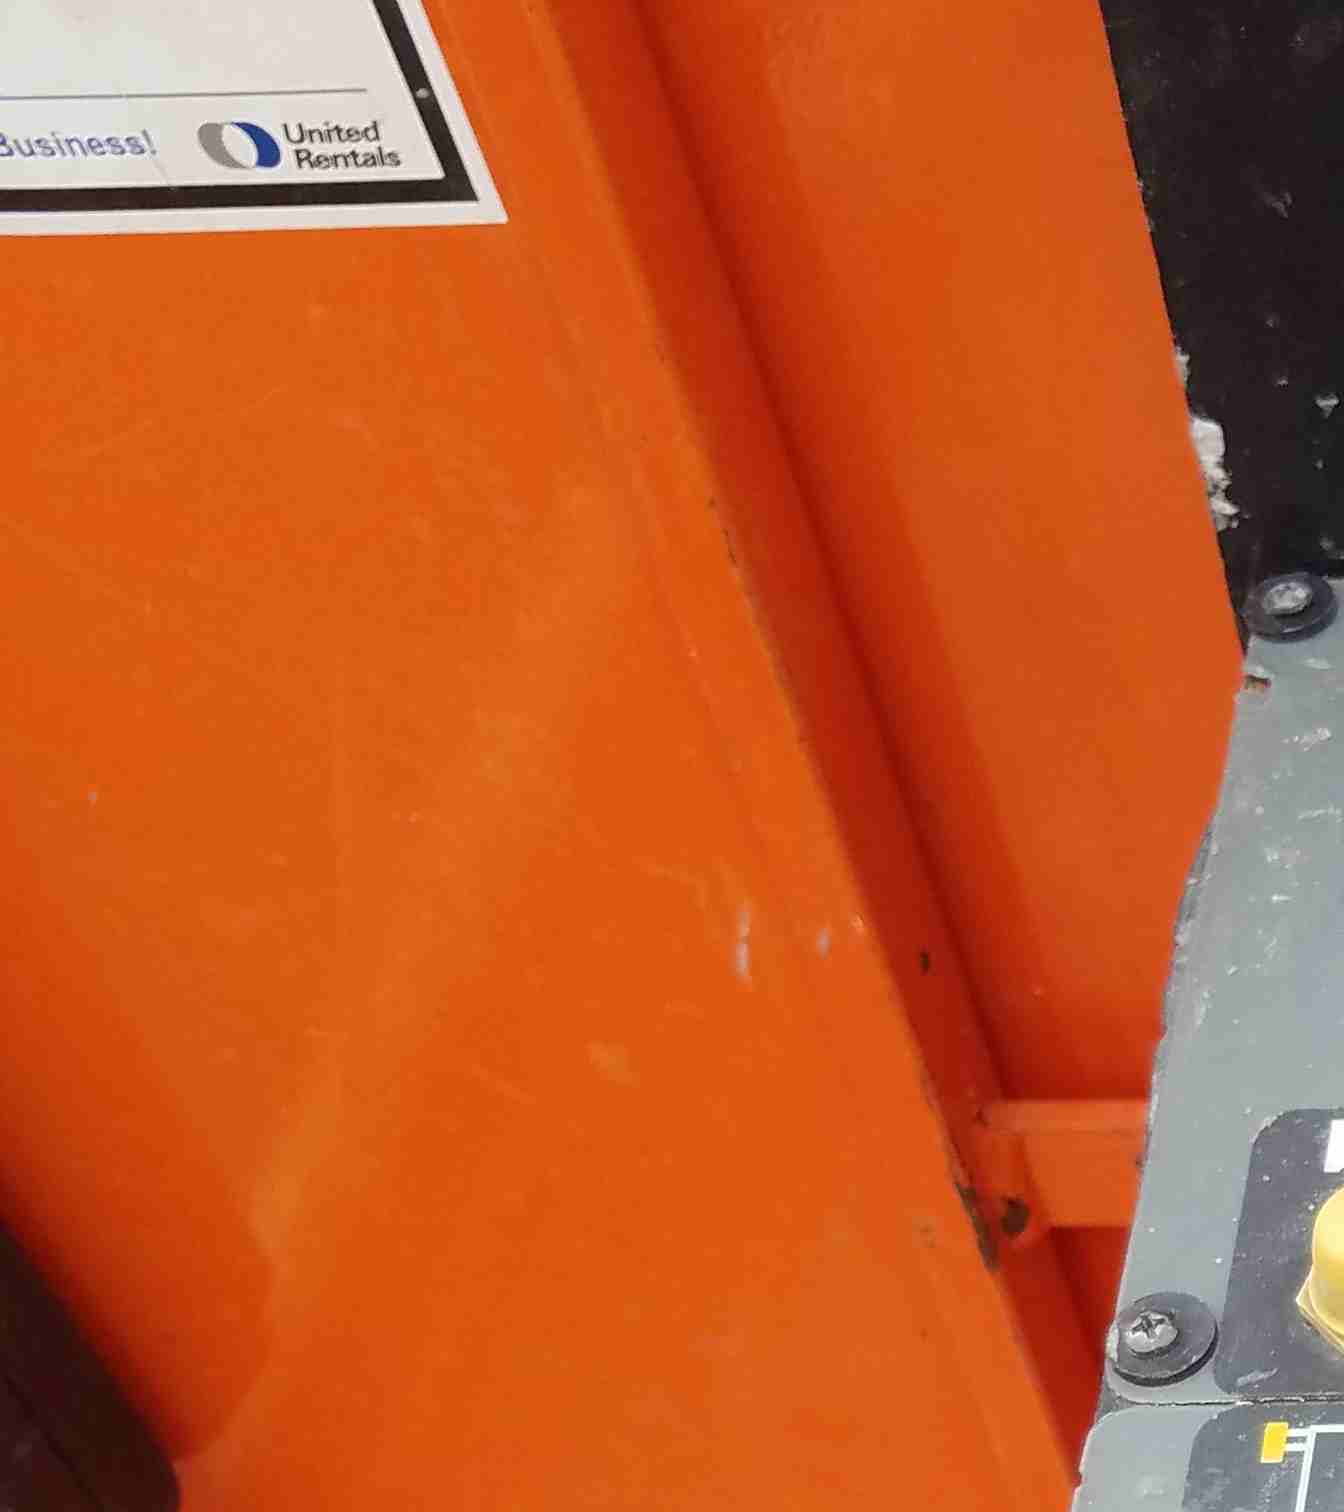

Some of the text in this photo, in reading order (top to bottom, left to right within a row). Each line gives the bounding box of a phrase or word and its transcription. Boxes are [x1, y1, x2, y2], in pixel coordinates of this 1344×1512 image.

[0, 129, 157, 158] Business!
[283, 119, 381, 145] United
[295, 146, 401, 171] Rentals
